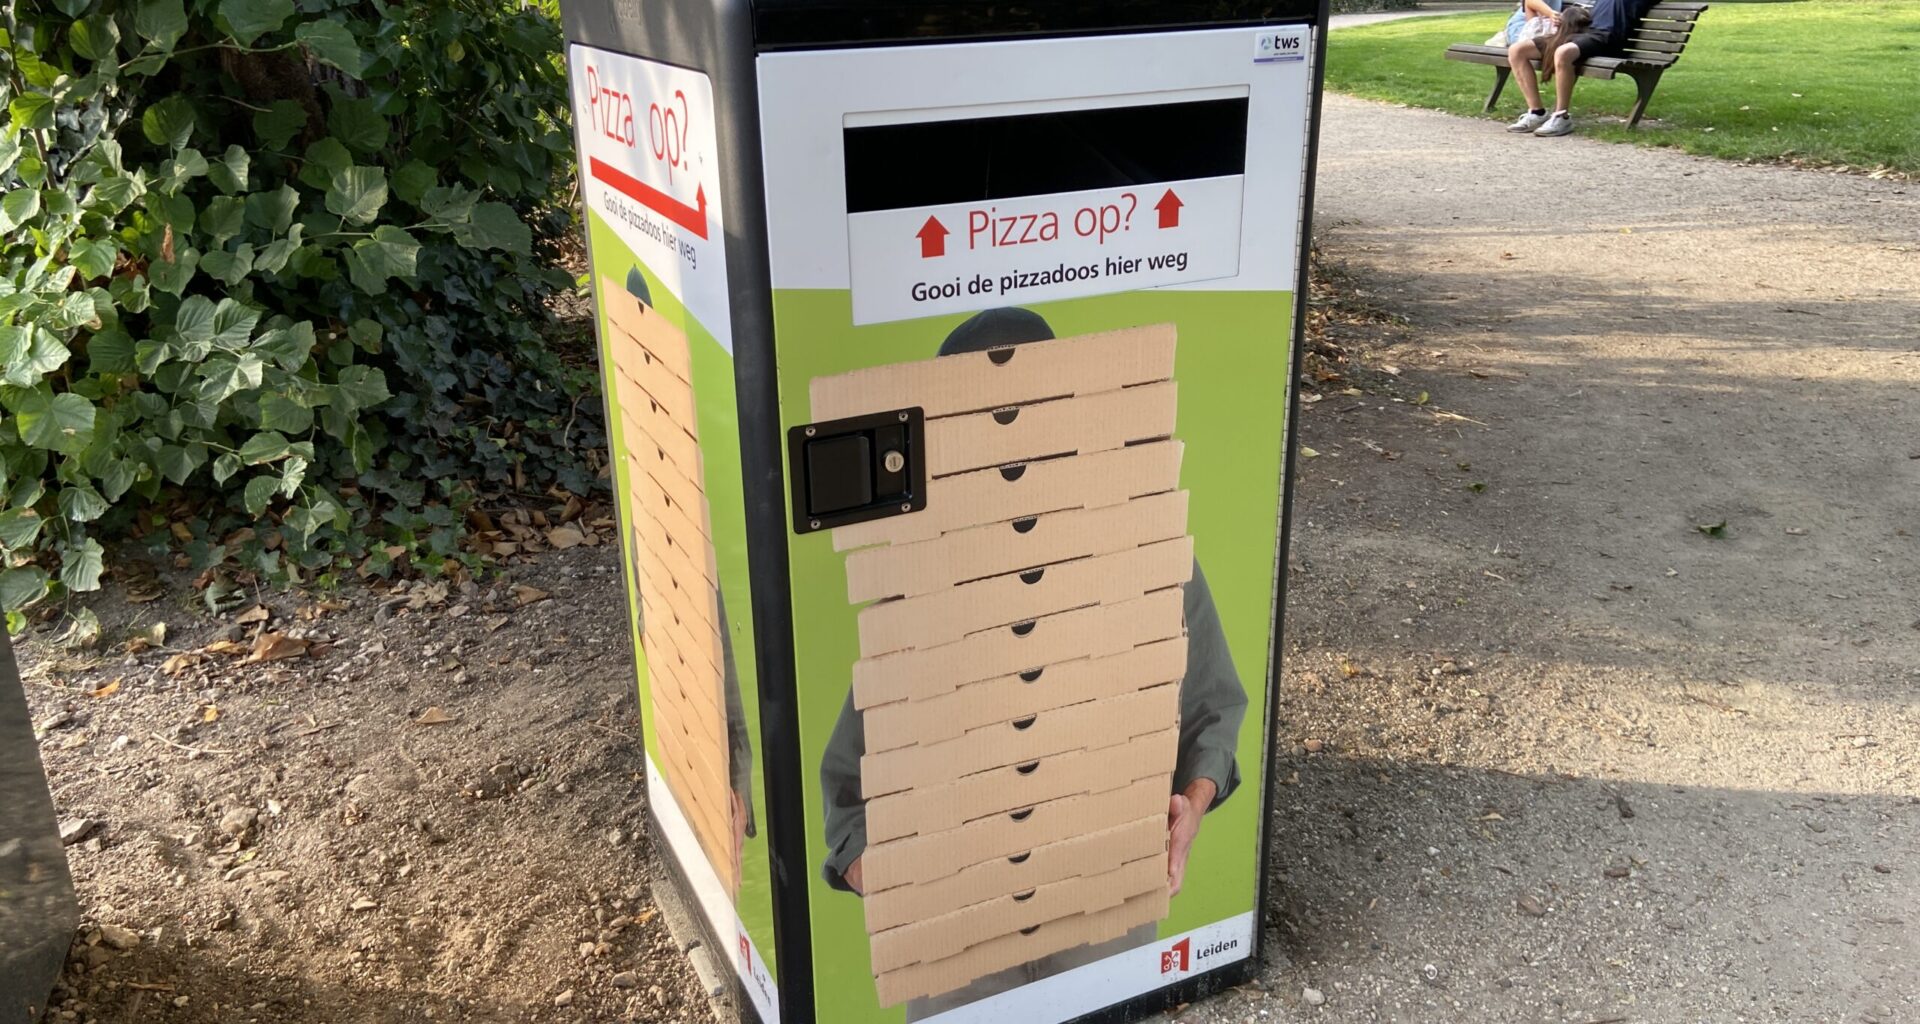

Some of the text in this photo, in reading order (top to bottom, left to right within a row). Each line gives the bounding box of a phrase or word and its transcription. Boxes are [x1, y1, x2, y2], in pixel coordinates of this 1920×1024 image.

[1274, 35, 1300, 50] tws
[586, 65, 689, 186] Pizza op?
[603, 191, 697, 271] Gooi de pizzadoos hier weg
[968, 193, 1138, 250] Pizza op?
[911, 251, 1189, 302] Gooi de pizzadoos hier weg
[1196, 938, 1238, 960] Leiden
